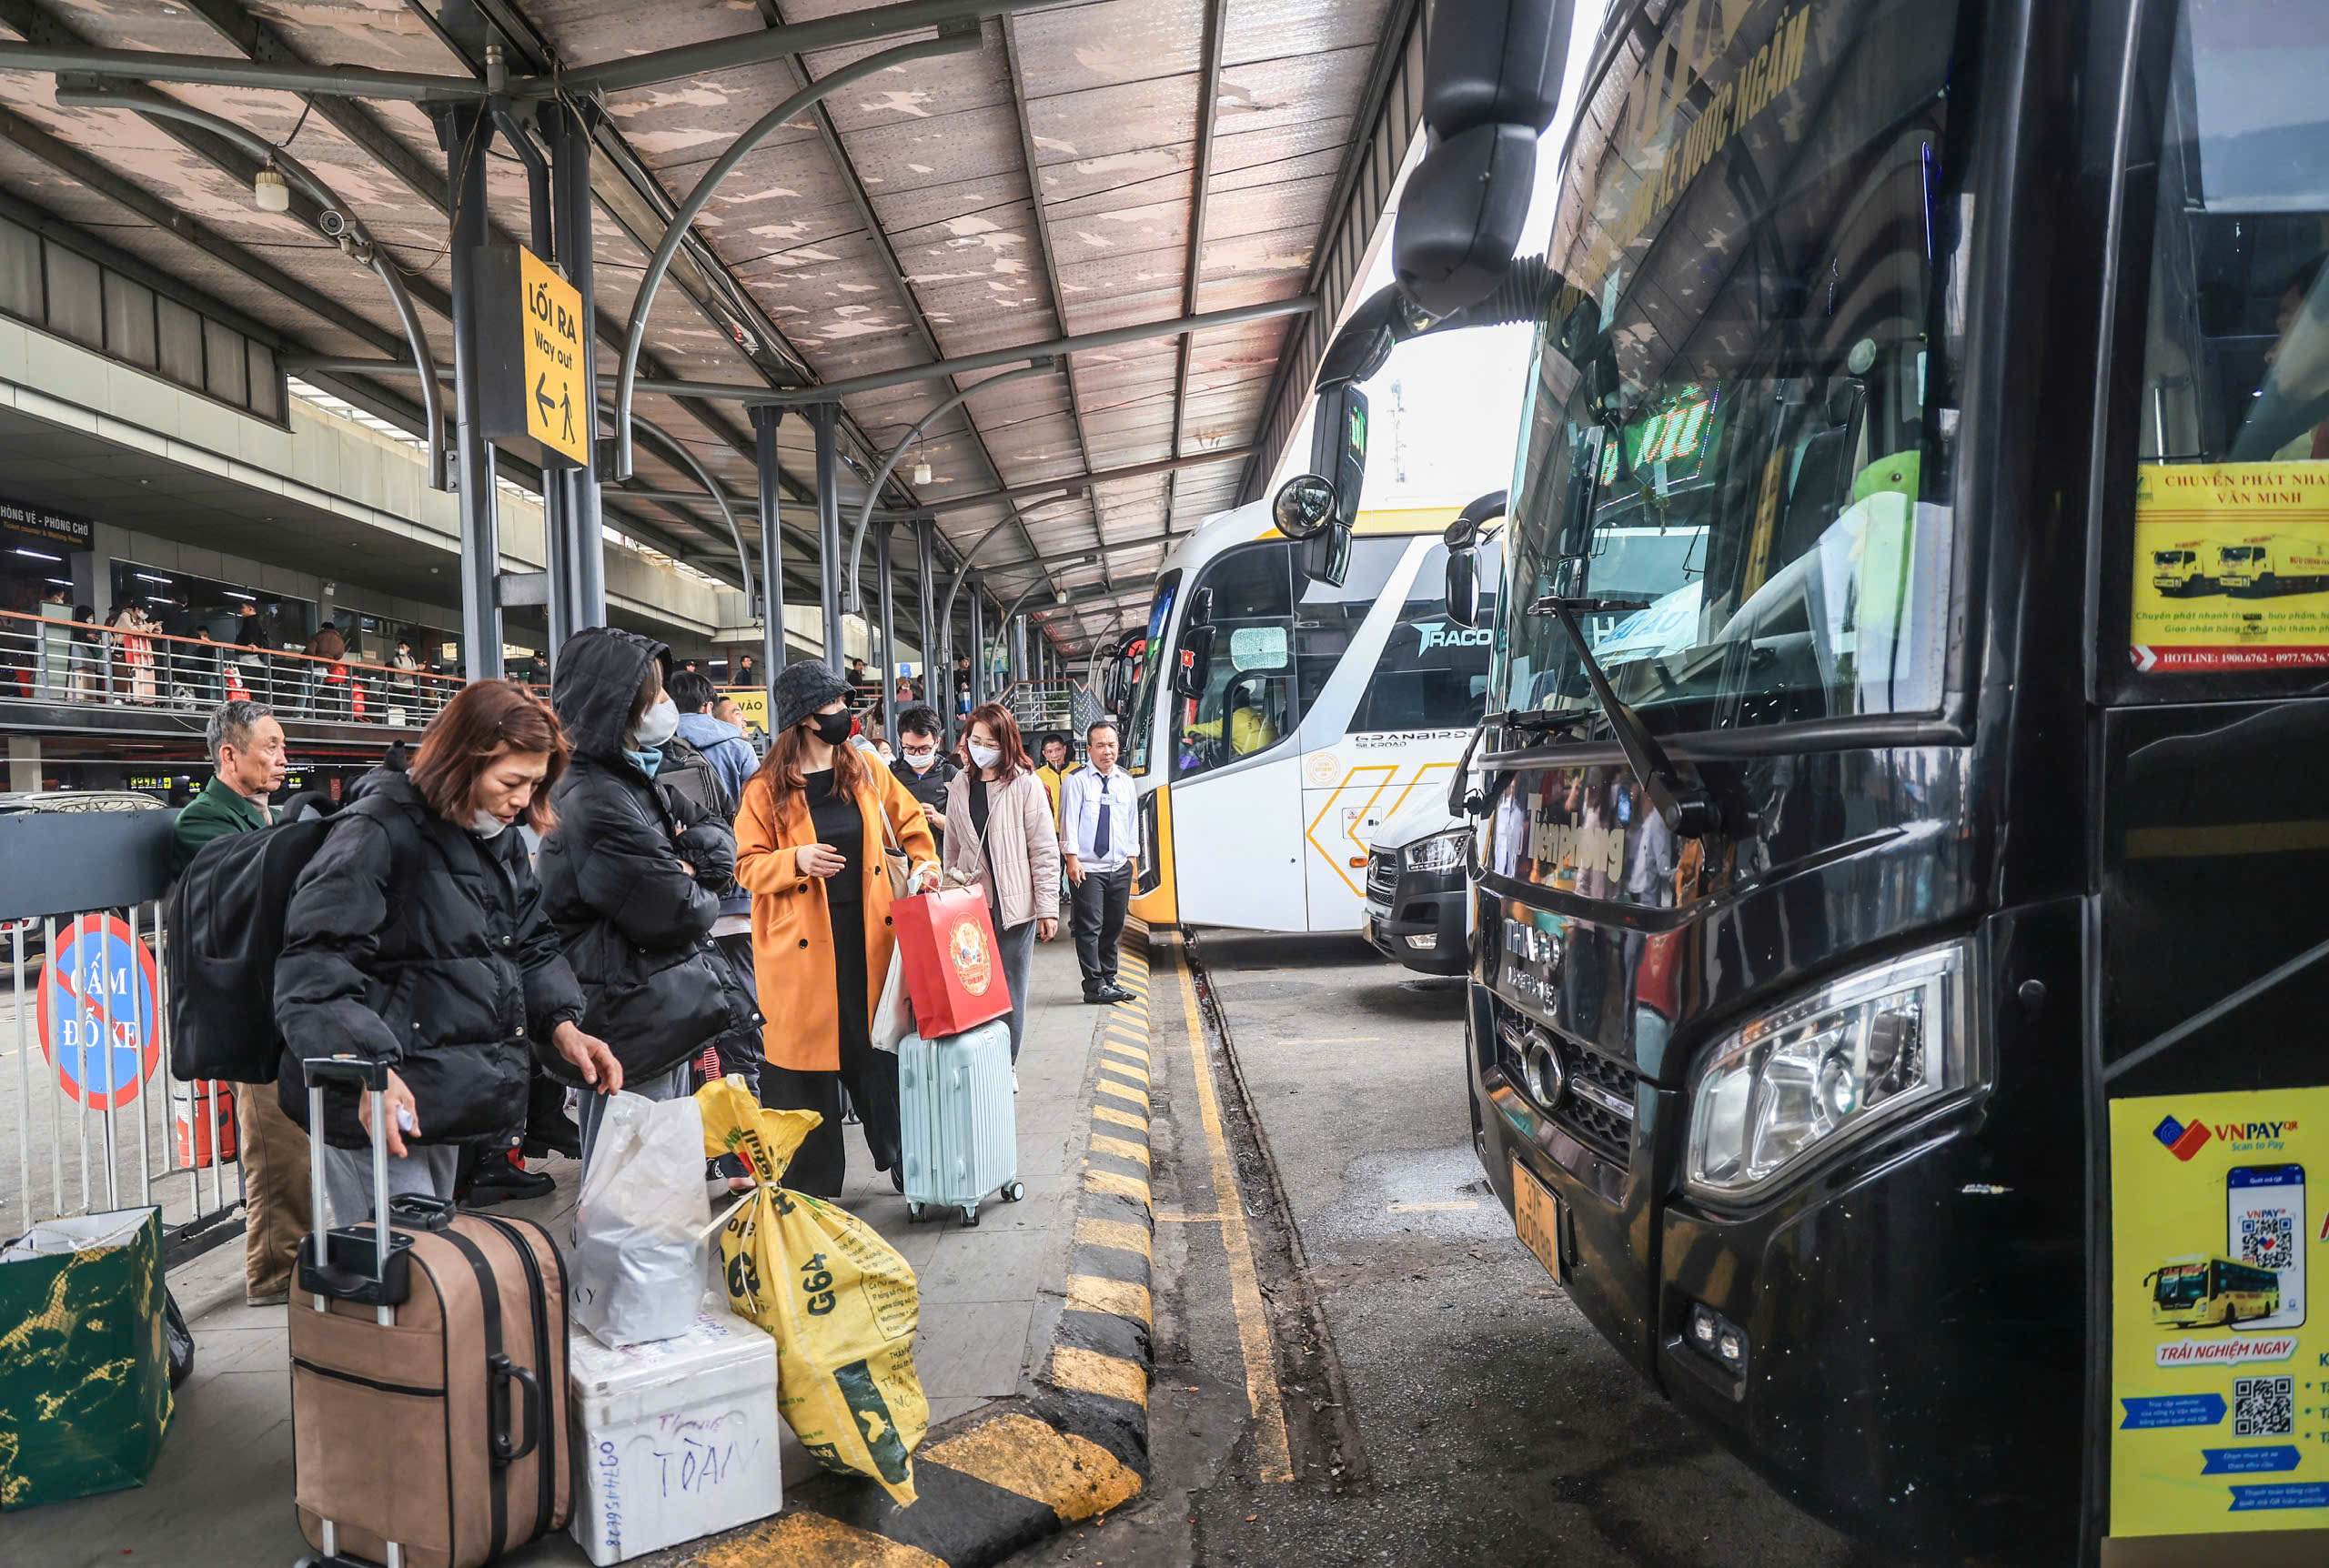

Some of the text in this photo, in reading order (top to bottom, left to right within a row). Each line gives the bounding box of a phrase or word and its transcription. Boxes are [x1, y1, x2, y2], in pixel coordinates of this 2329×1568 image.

[529, 282, 577, 344] LỐI RA
[534, 327, 573, 370] Way out
[2164, 469, 2329, 487] CHUYỂN PHÁT NHA
[2217, 489, 2303, 504] VĂN MINH
[2198, 610, 2228, 619] nhanh
[2164, 624, 2187, 633] Giao
[1410, 622, 1493, 658] TRACO
[2163, 652, 2218, 664] HOTLINE:
[2222, 652, 2268, 664] 1900.6762
[1356, 741, 1406, 749] SILKROAD
[70, 952, 127, 995] CẤM
[63, 1005, 137, 1048] ĐỖ XE
[2232, 1139, 2284, 1151] Scan to Pay
[801, 1252, 836, 1316] G64
[2194, 1341, 2250, 1359] NGHIỆM
[2252, 1340, 2292, 1355] NGAY
